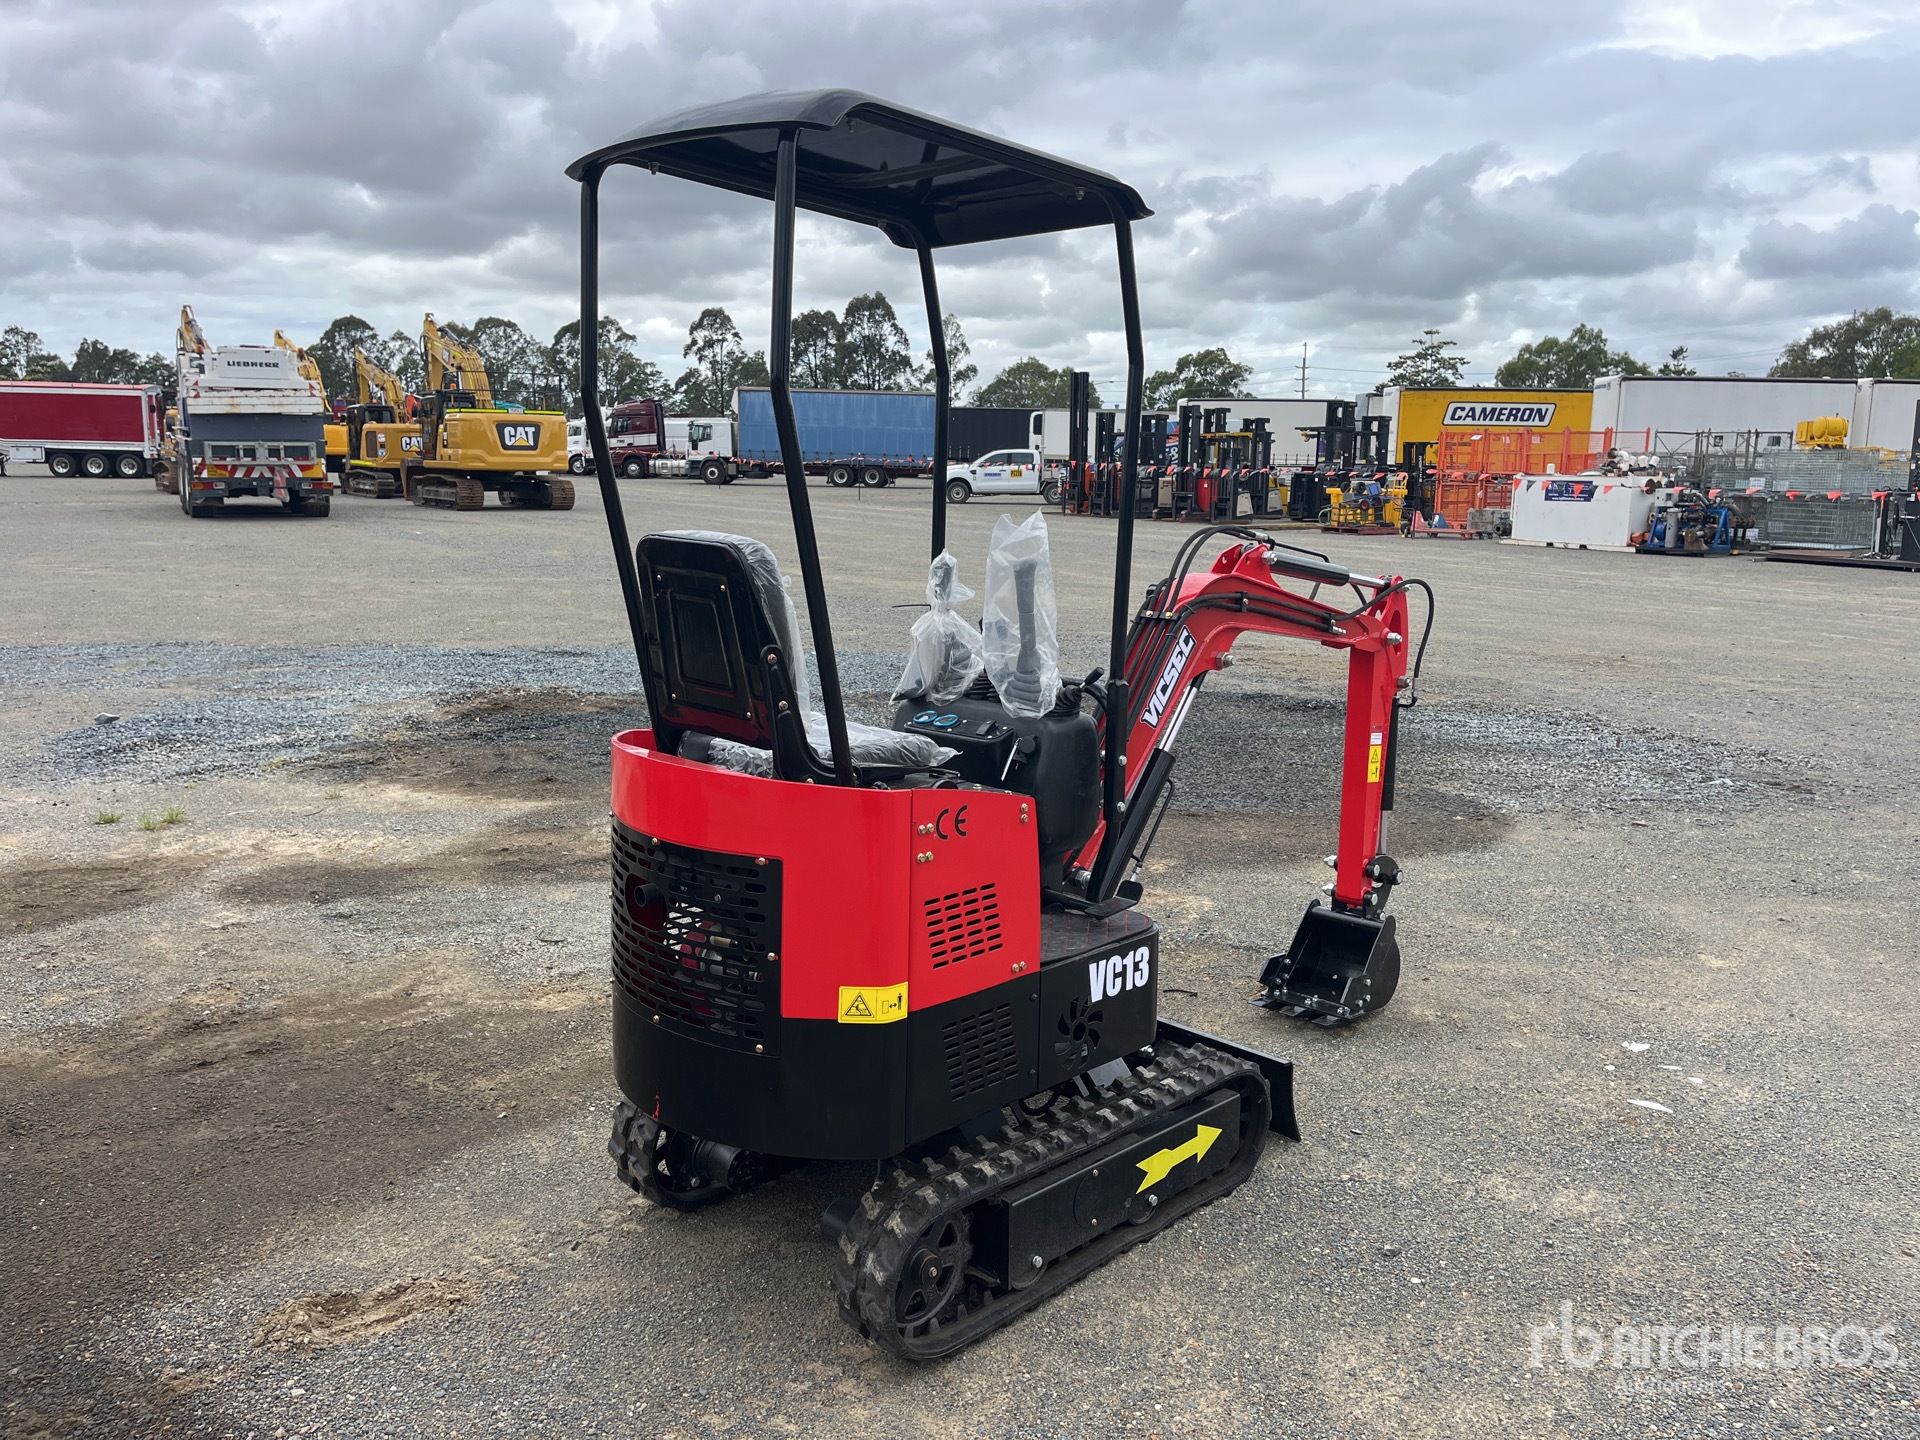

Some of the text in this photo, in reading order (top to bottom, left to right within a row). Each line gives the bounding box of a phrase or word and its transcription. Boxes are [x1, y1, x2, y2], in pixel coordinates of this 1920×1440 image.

[1450, 406, 1549, 422] CAMERON
[504, 426, 536, 446] CAT
[1141, 626, 1196, 728] VICSEC
[936, 804, 968, 840] CE
[1089, 946, 1150, 1003] VC13
